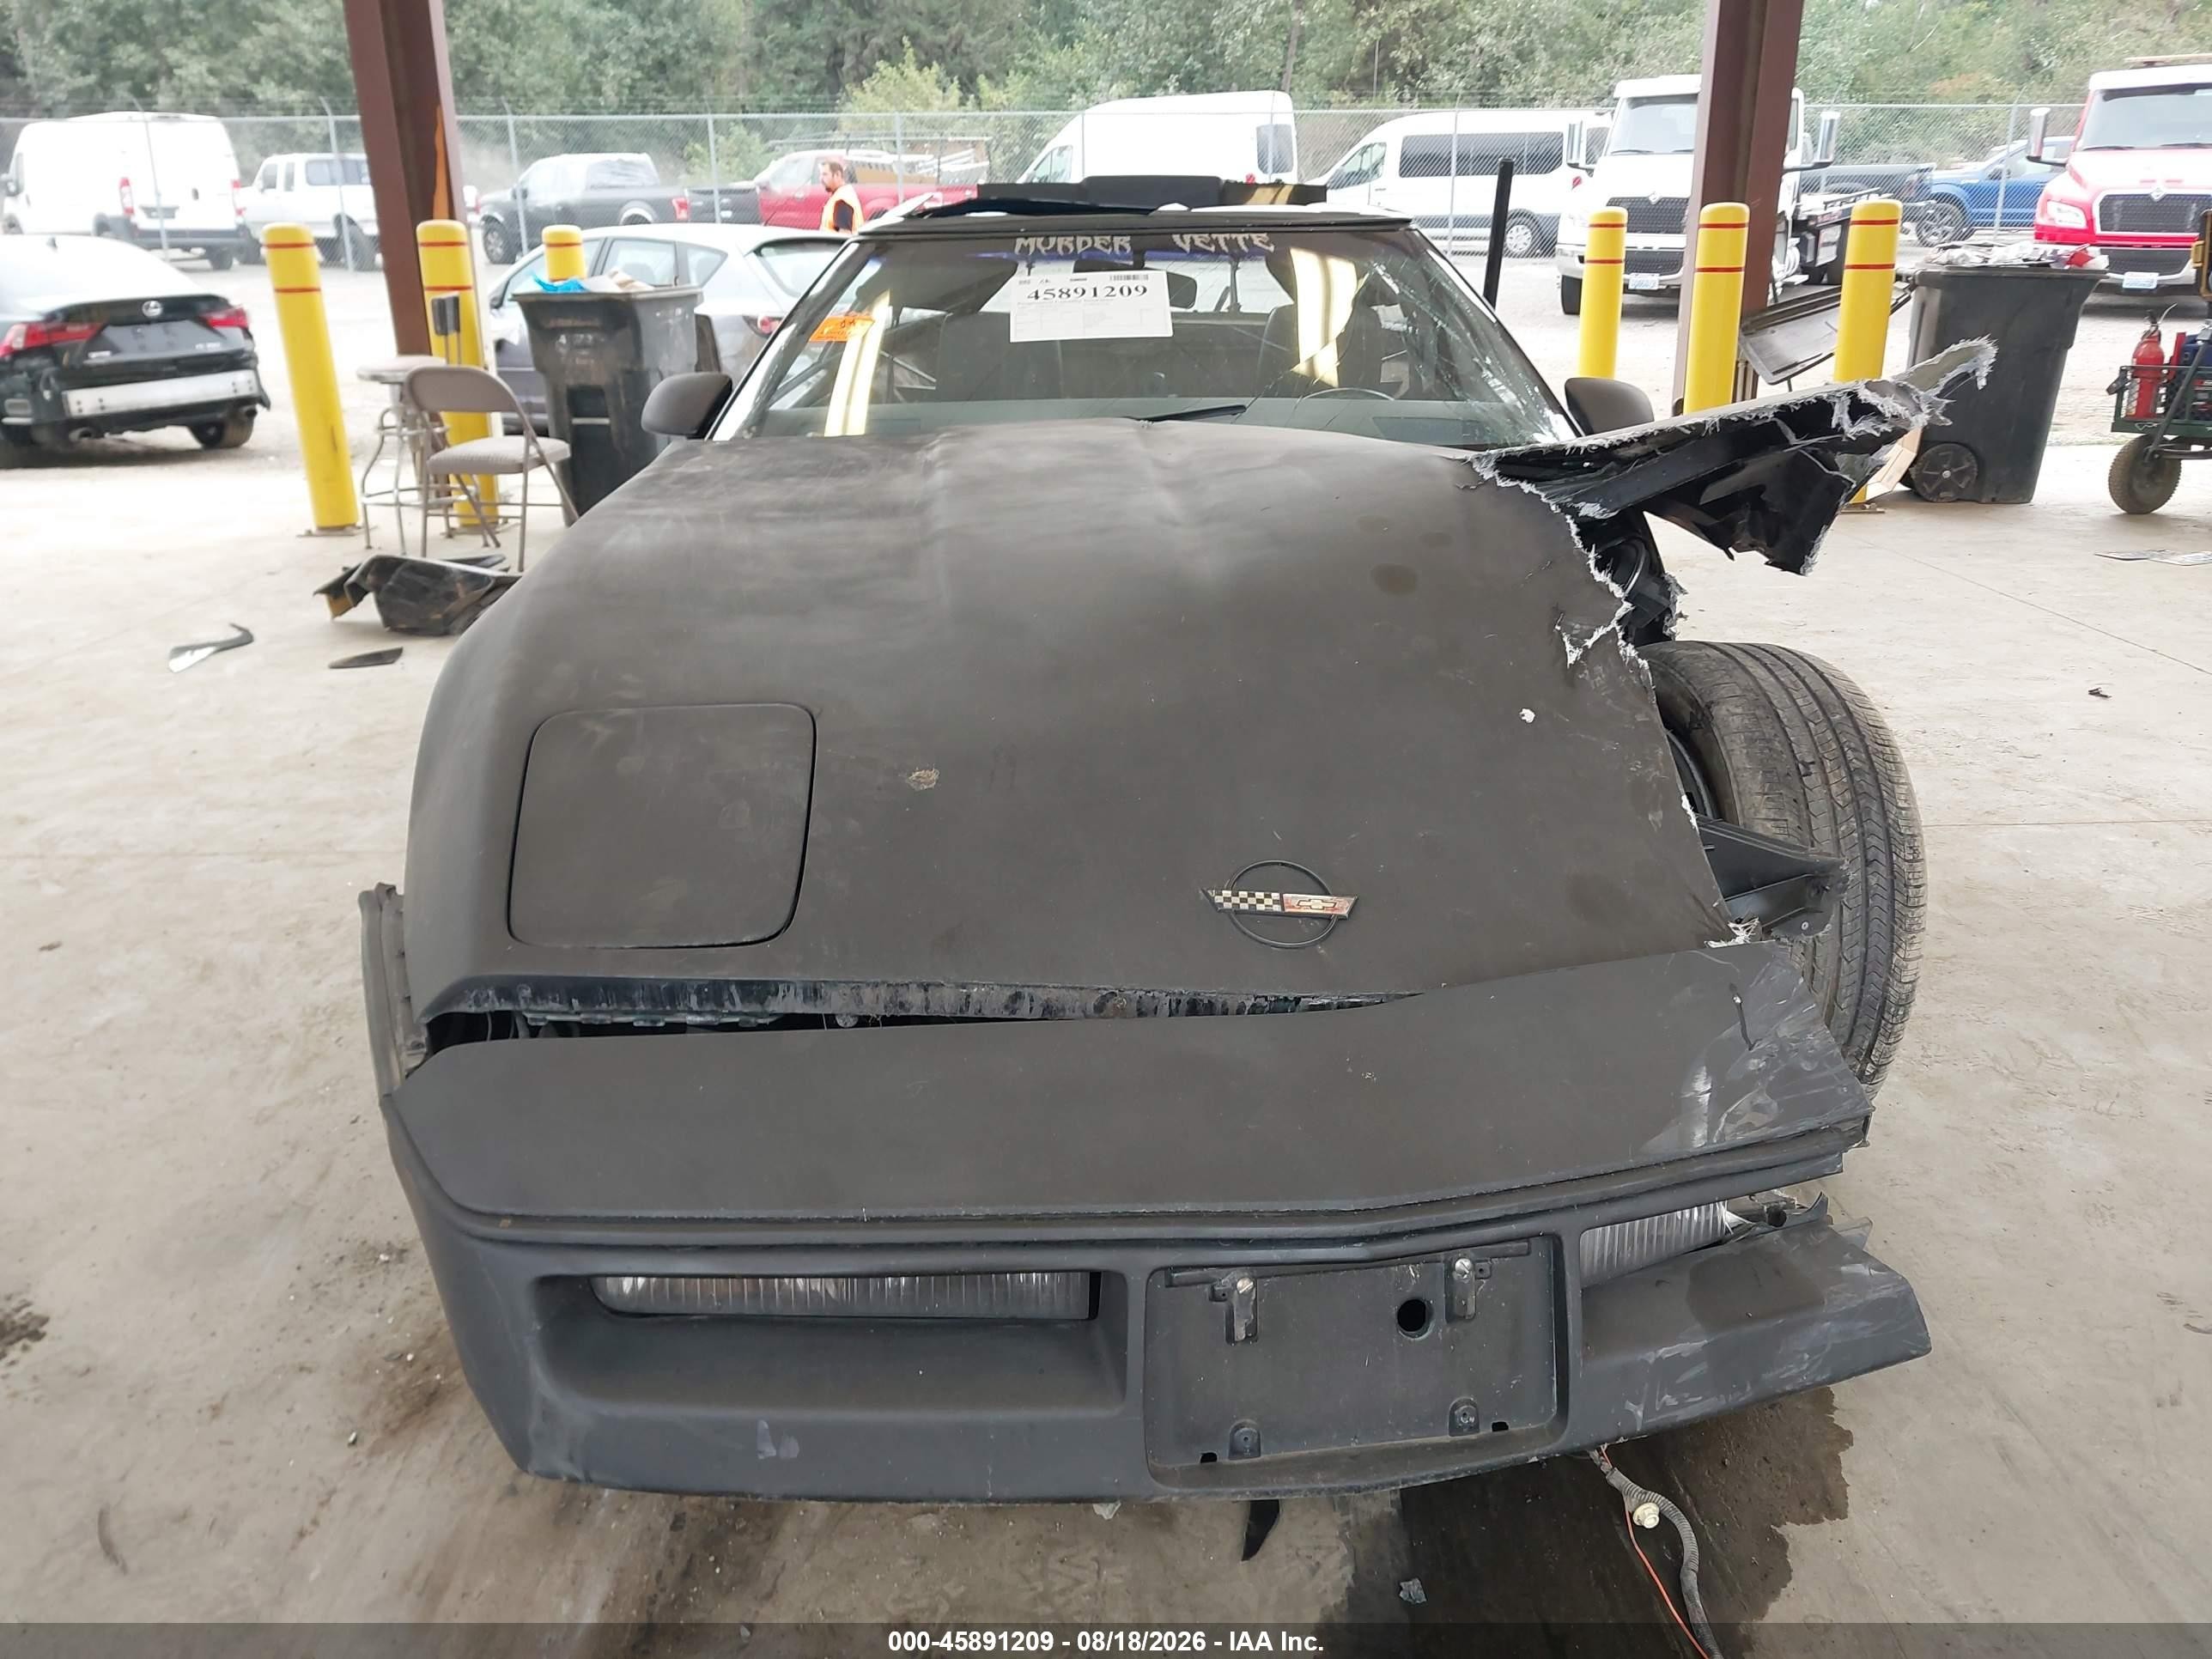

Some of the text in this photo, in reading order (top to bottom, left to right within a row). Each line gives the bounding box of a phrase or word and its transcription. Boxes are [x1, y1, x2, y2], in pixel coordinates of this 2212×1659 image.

[1014, 233, 1276, 255] MURDER VETTE
[1027, 284, 1149, 301] 45891209
